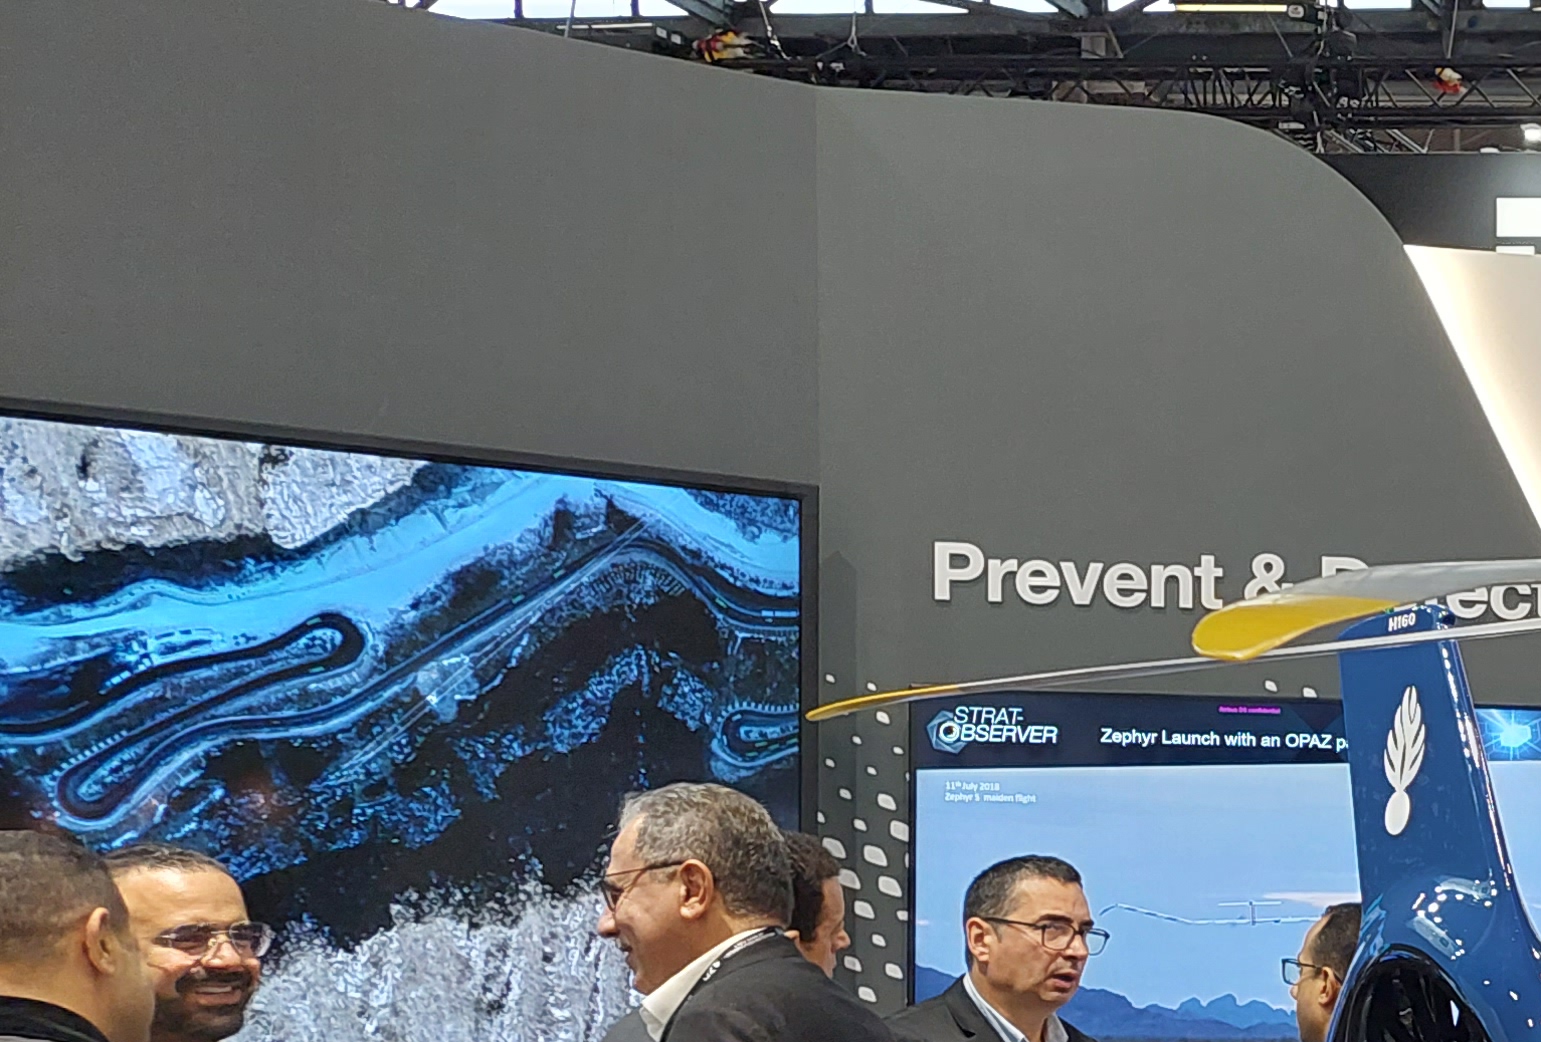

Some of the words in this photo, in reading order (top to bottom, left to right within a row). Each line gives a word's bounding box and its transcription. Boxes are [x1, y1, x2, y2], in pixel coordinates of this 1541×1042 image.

[933, 541, 1223, 610] Prevent
[1388, 612, 1416, 632] H160
[954, 706, 1024, 725] STRAT-
[938, 720, 1058, 744] OBSERVER
[1100, 728, 1158, 748] Zephyr
[1161, 730, 1220, 746] Launch
[1224, 732, 1256, 747] with
[1260, 736, 1281, 747] an
[1285, 733, 1332, 749] OPAZ
